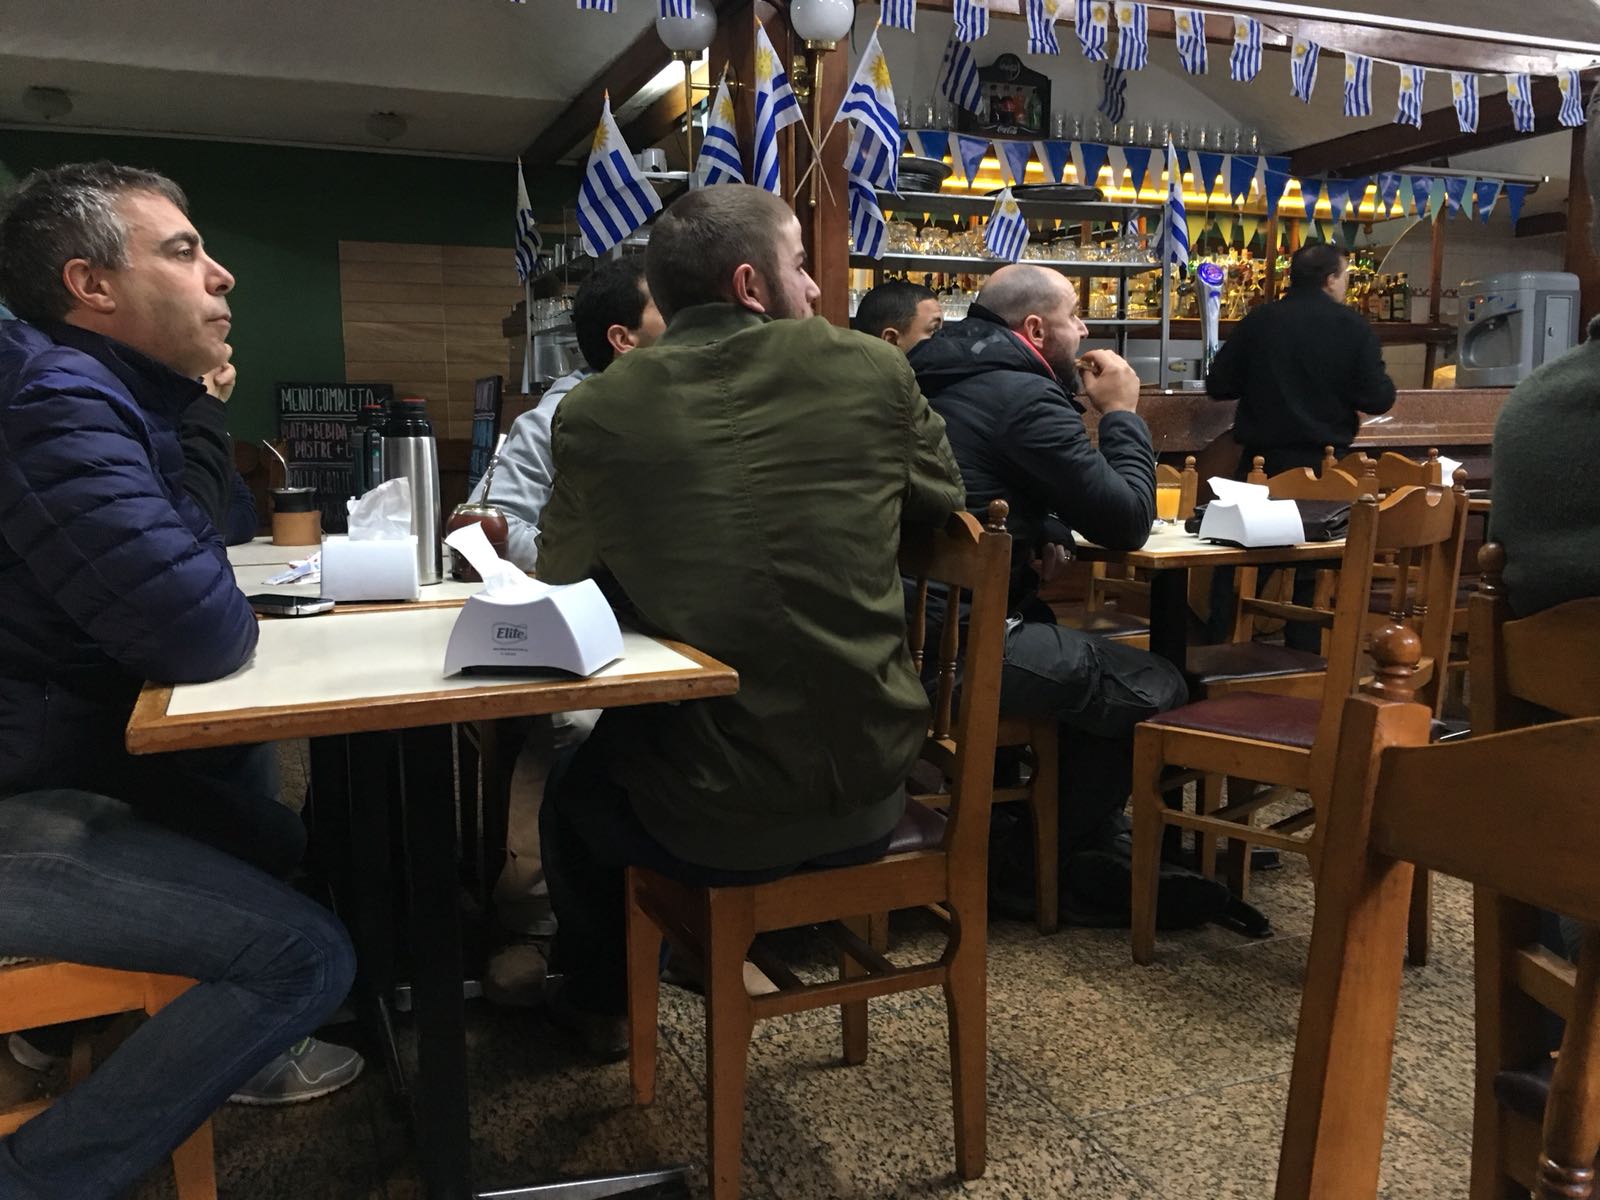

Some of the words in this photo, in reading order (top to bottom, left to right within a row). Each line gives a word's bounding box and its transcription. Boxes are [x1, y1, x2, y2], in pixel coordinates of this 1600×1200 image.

[315, 387, 374, 412] COMPLETO
[295, 441, 333, 458] POSTRE
[496, 627, 525, 639] Elite
